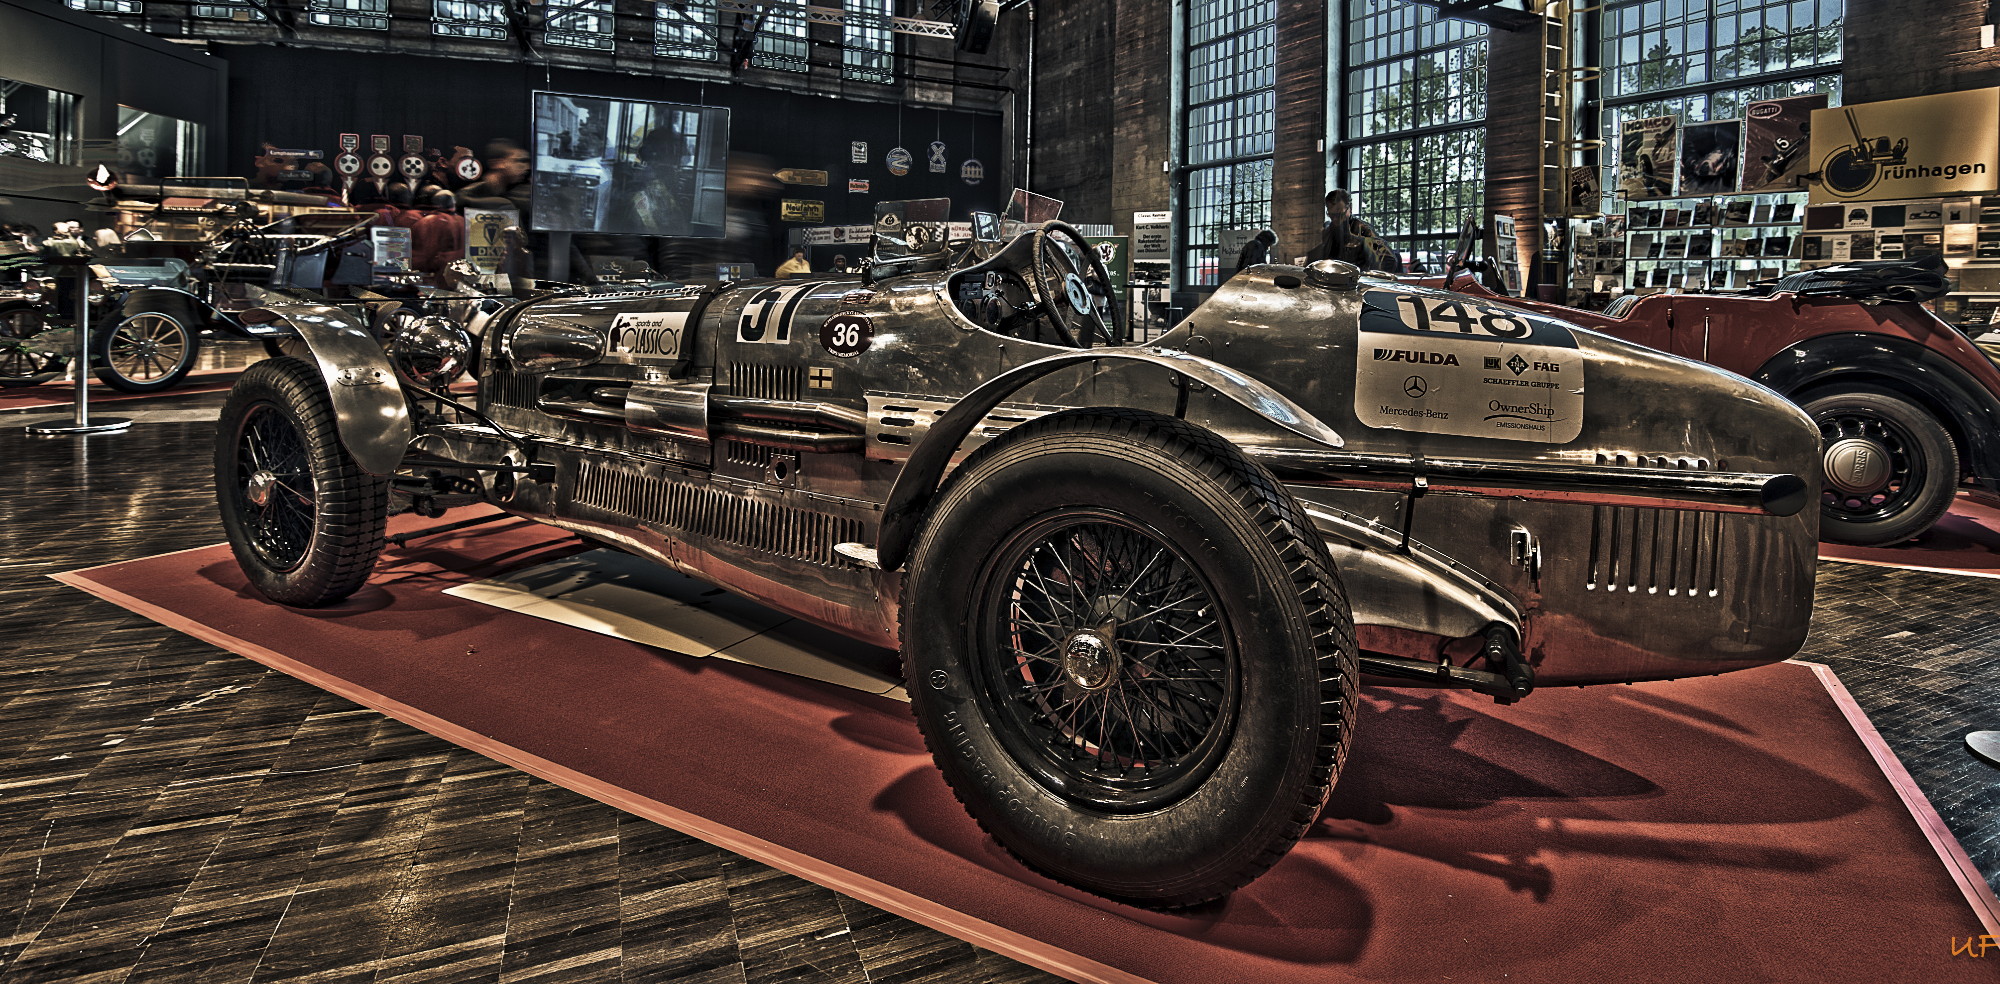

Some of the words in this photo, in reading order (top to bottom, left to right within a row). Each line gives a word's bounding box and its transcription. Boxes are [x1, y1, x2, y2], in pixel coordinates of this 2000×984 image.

[1751, 106, 1778, 116] BUGATTI
[1625, 117, 1671, 132] MONACO
[1776, 137, 1790, 149] 5
[635, 319, 651, 329] sports
[651, 318, 664, 327] and
[1397, 296, 1528, 339] 148
[621, 327, 679, 355] CLASSICS
[832, 322, 860, 347] 36
[1392, 349, 1460, 367] FULDA
[1533, 361, 1560, 372] FAG
[1483, 377, 1530, 387] SCHAEFFLER
[1530, 381, 1560, 390] GRUPPE
[1379, 405, 1449, 420] Mercedes-Benz
[1489, 400, 1555, 418] OwnerShip
[1496, 421, 1546, 431] EMISSIONSHAUS
[943, 711, 997, 788] RACING
[997, 789, 1077, 850] DUNLOP
